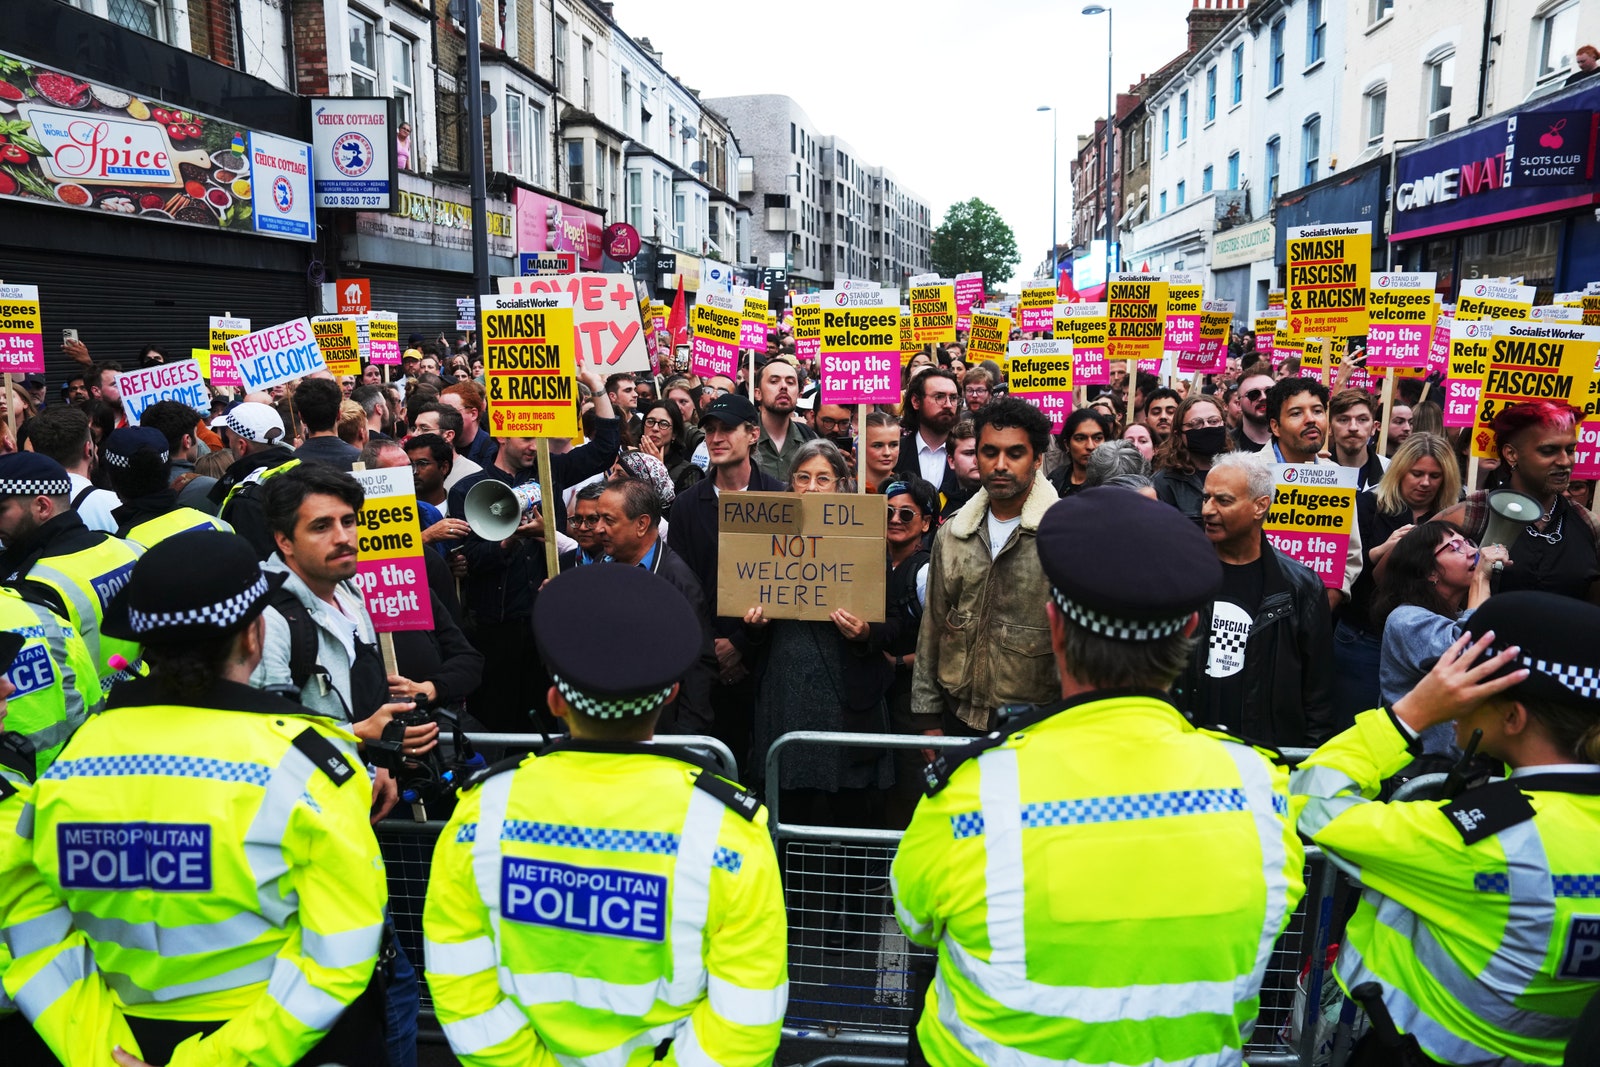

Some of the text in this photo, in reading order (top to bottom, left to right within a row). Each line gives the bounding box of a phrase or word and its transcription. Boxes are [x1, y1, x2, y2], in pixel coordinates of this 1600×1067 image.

[318, 114, 384, 125] CHICK COTTAGE
[44, 128, 69, 138] WORLD
[82, 128, 94, 142] of
[54, 120, 168, 177] Spice
[255, 152, 306, 175] CHICK COTTAGE
[1520, 155, 1580, 166] SLOTS CLUB
[1532, 166, 1575, 176] LOUNGE
[1396, 168, 1459, 212] GAME
[324, 196, 380, 205] 020 8520 7337
[563, 220, 585, 246] Pepe's
[1290, 240, 1344, 262] SMASH
[528, 260, 568, 269] MAGAZIN
[1290, 264, 1356, 286] FASCISM
[912, 288, 940, 300] SMASH
[1022, 290, 1055, 298] Refugees
[1110, 285, 1150, 299] SMASH
[1290, 292, 1302, 310] &
[1308, 288, 1366, 308] RACISM
[1370, 292, 1430, 307] Refugees
[912, 302, 948, 314] FASCISM
[1110, 304, 1158, 318] FASCISM
[1369, 308, 1426, 320] welcome
[1460, 300, 1526, 318] Refugees
[698, 308, 739, 326] Refugees
[824, 312, 896, 330] Refugees
[922, 315, 953, 326] RACISM
[974, 316, 998, 328] SMASH
[1177, 318, 1194, 328] the
[1304, 316, 1348, 326] By any means
[314, 324, 342, 334] SMASH
[370, 322, 396, 330] Refugees
[486, 314, 546, 338] SMASH
[697, 324, 736, 340] welcome
[1056, 320, 1106, 333] Refugees
[1108, 322, 1162, 336] & RACISM
[1304, 325, 1336, 334] necessary
[824, 332, 893, 346] welcome
[972, 328, 1002, 340] FASCISM
[1168, 331, 1193, 344] right
[1404, 327, 1422, 341] the
[10, 336, 34, 348] the
[231, 322, 306, 361] REFUGEES
[372, 342, 386, 350] Stop
[978, 340, 1006, 352] RACISM
[1276, 340, 1304, 348] welcome
[326, 350, 358, 360] RACISM
[382, 350, 398, 360] right
[696, 340, 732, 359] Stop the
[1274, 350, 1290, 358] Stop
[1386, 344, 1420, 359] right
[1492, 340, 1564, 367] SMASH
[0, 350, 34, 365] right
[213, 356, 232, 368] Stop
[488, 345, 560, 369] FASCISM
[1084, 352, 1102, 362] the
[1196, 352, 1214, 364] right
[240, 342, 322, 388] WELCOME
[695, 356, 730, 374] far right
[825, 356, 890, 376] Stop the
[1012, 358, 1070, 374] Refugees
[1076, 364, 1102, 379] right
[120, 363, 198, 396] REFUGEES
[213, 368, 225, 378] far
[490, 376, 572, 400] & RACISM
[825, 376, 890, 394] far right
[1012, 374, 1066, 388] welcome
[1486, 370, 1574, 398] FASCISM
[1043, 395, 1064, 408] the
[1449, 400, 1471, 414] far
[506, 410, 556, 422] By any means
[1480, 400, 1496, 422] &
[506, 422, 543, 432] necessary
[376, 475, 388, 484] UP
[1300, 469, 1324, 477] STAND
[1310, 477, 1338, 485] RACISM
[1274, 489, 1350, 510] Refugees
[724, 502, 864, 526] FARAGE EDL
[1267, 509, 1344, 528] welcome
[772, 534, 823, 558] NOT
[1306, 536, 1336, 554] the
[381, 564, 416, 586] the
[737, 562, 854, 582] WELCOME
[760, 585, 827, 606] HERE
[370, 590, 420, 618] right
[1469, 808, 1486, 822] CE
[65, 829, 204, 847] METROPOLITAN
[66, 848, 204, 884] POLICE
[508, 863, 660, 898] METROPOLITAN
[507, 883, 658, 934] POLICE
